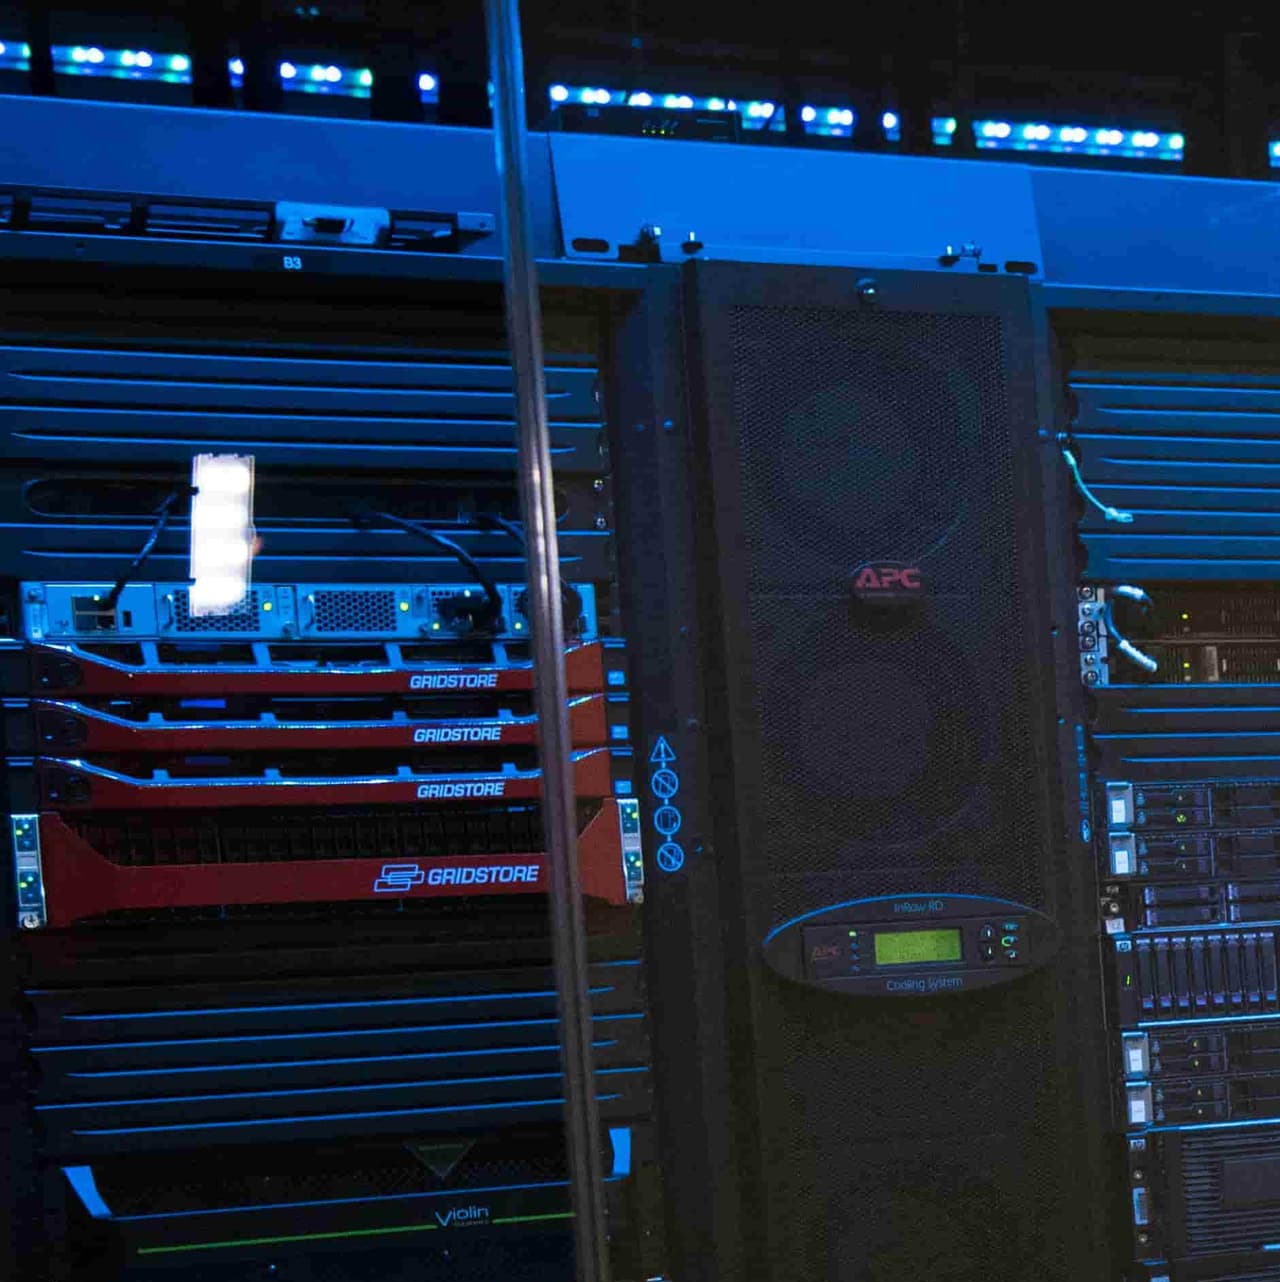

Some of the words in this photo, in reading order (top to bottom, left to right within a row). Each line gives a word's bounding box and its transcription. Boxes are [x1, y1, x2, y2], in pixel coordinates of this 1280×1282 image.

[283, 255, 302, 270] B3
[855, 565, 921, 589] APC
[409, 673, 499, 690] GRIDSTORE
[413, 726, 502, 743] GRIDSTORE
[416, 782, 506, 799] GRIDSTORE
[427, 865, 541, 887] GRIDSTORE
